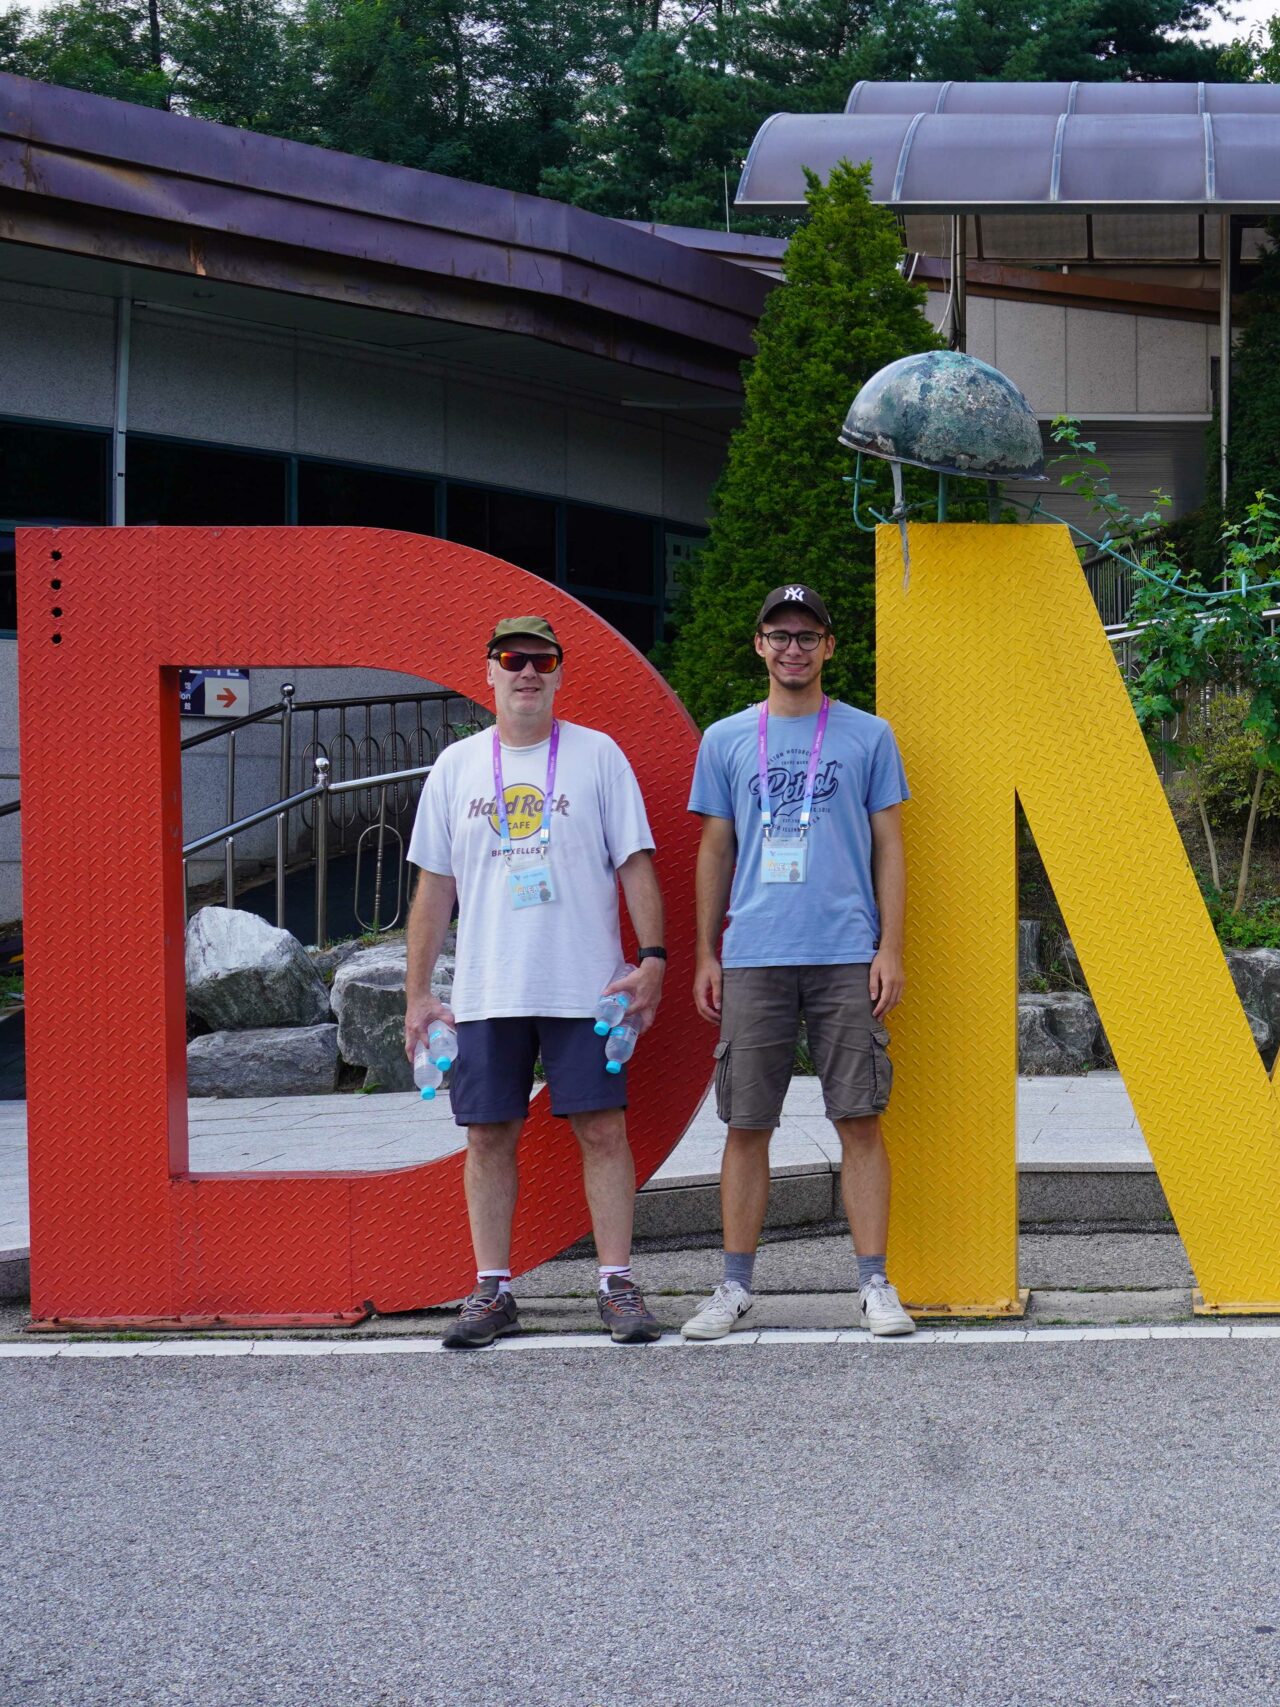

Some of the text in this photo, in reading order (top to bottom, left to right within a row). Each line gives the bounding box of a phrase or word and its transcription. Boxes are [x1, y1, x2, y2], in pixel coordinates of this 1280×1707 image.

[783, 586, 805, 602] NY
[748, 760, 838, 813] Petol
[491, 847, 542, 857] BRXELLES
